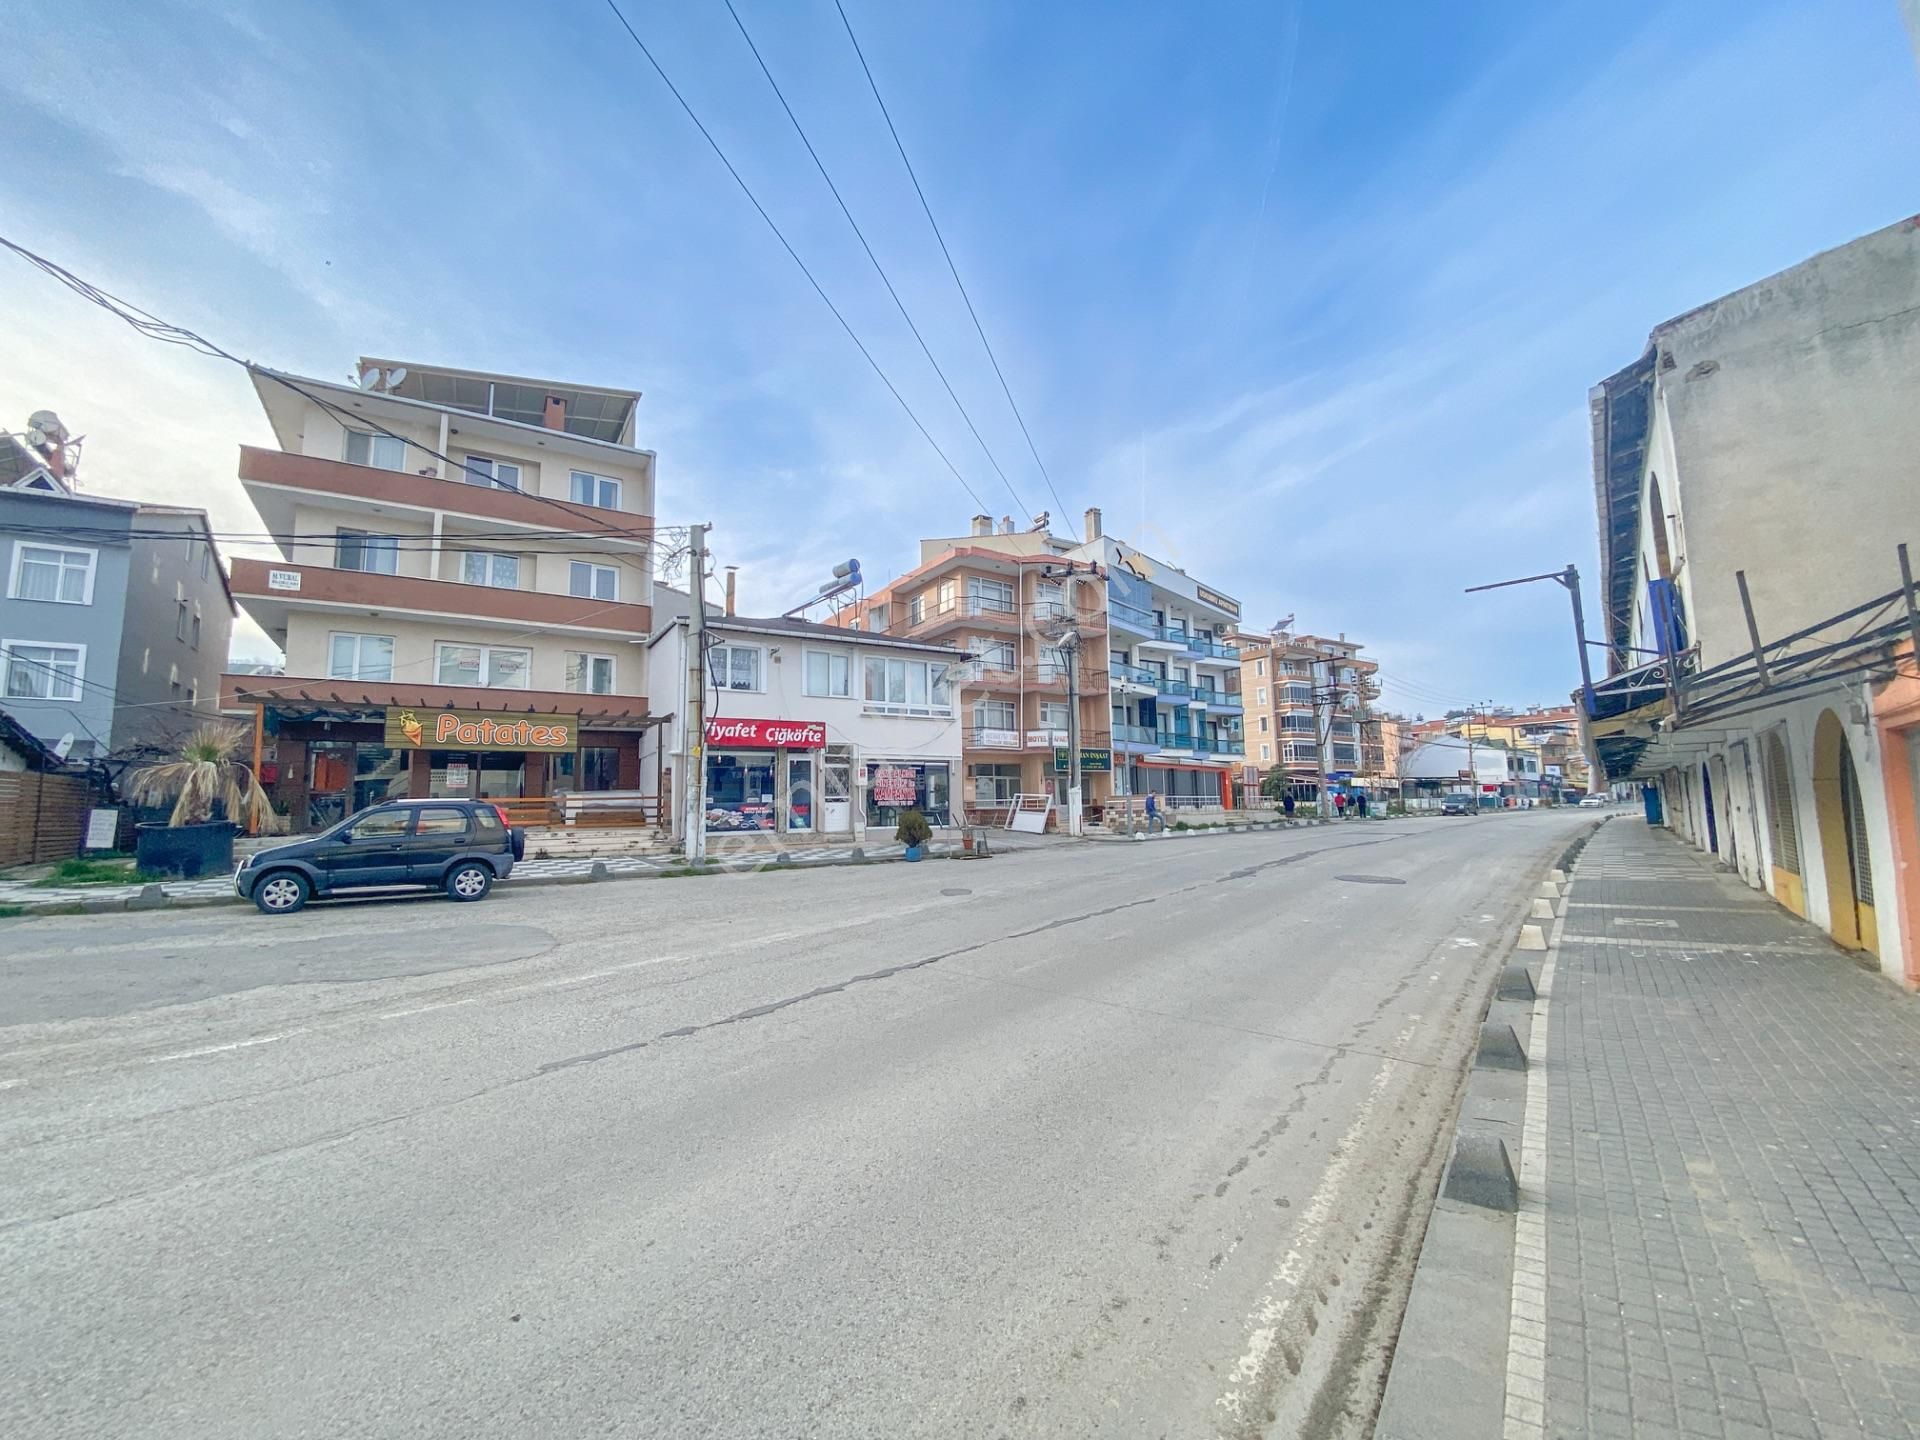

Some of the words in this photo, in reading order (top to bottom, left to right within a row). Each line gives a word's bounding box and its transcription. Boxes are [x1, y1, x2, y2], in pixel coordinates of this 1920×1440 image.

[436, 713, 568, 747] Patates
[765, 727, 822, 744] Çiğköfte
[1028, 735, 1048, 743] MOTEL
[874, 787, 917, 801] KAMPANYA
